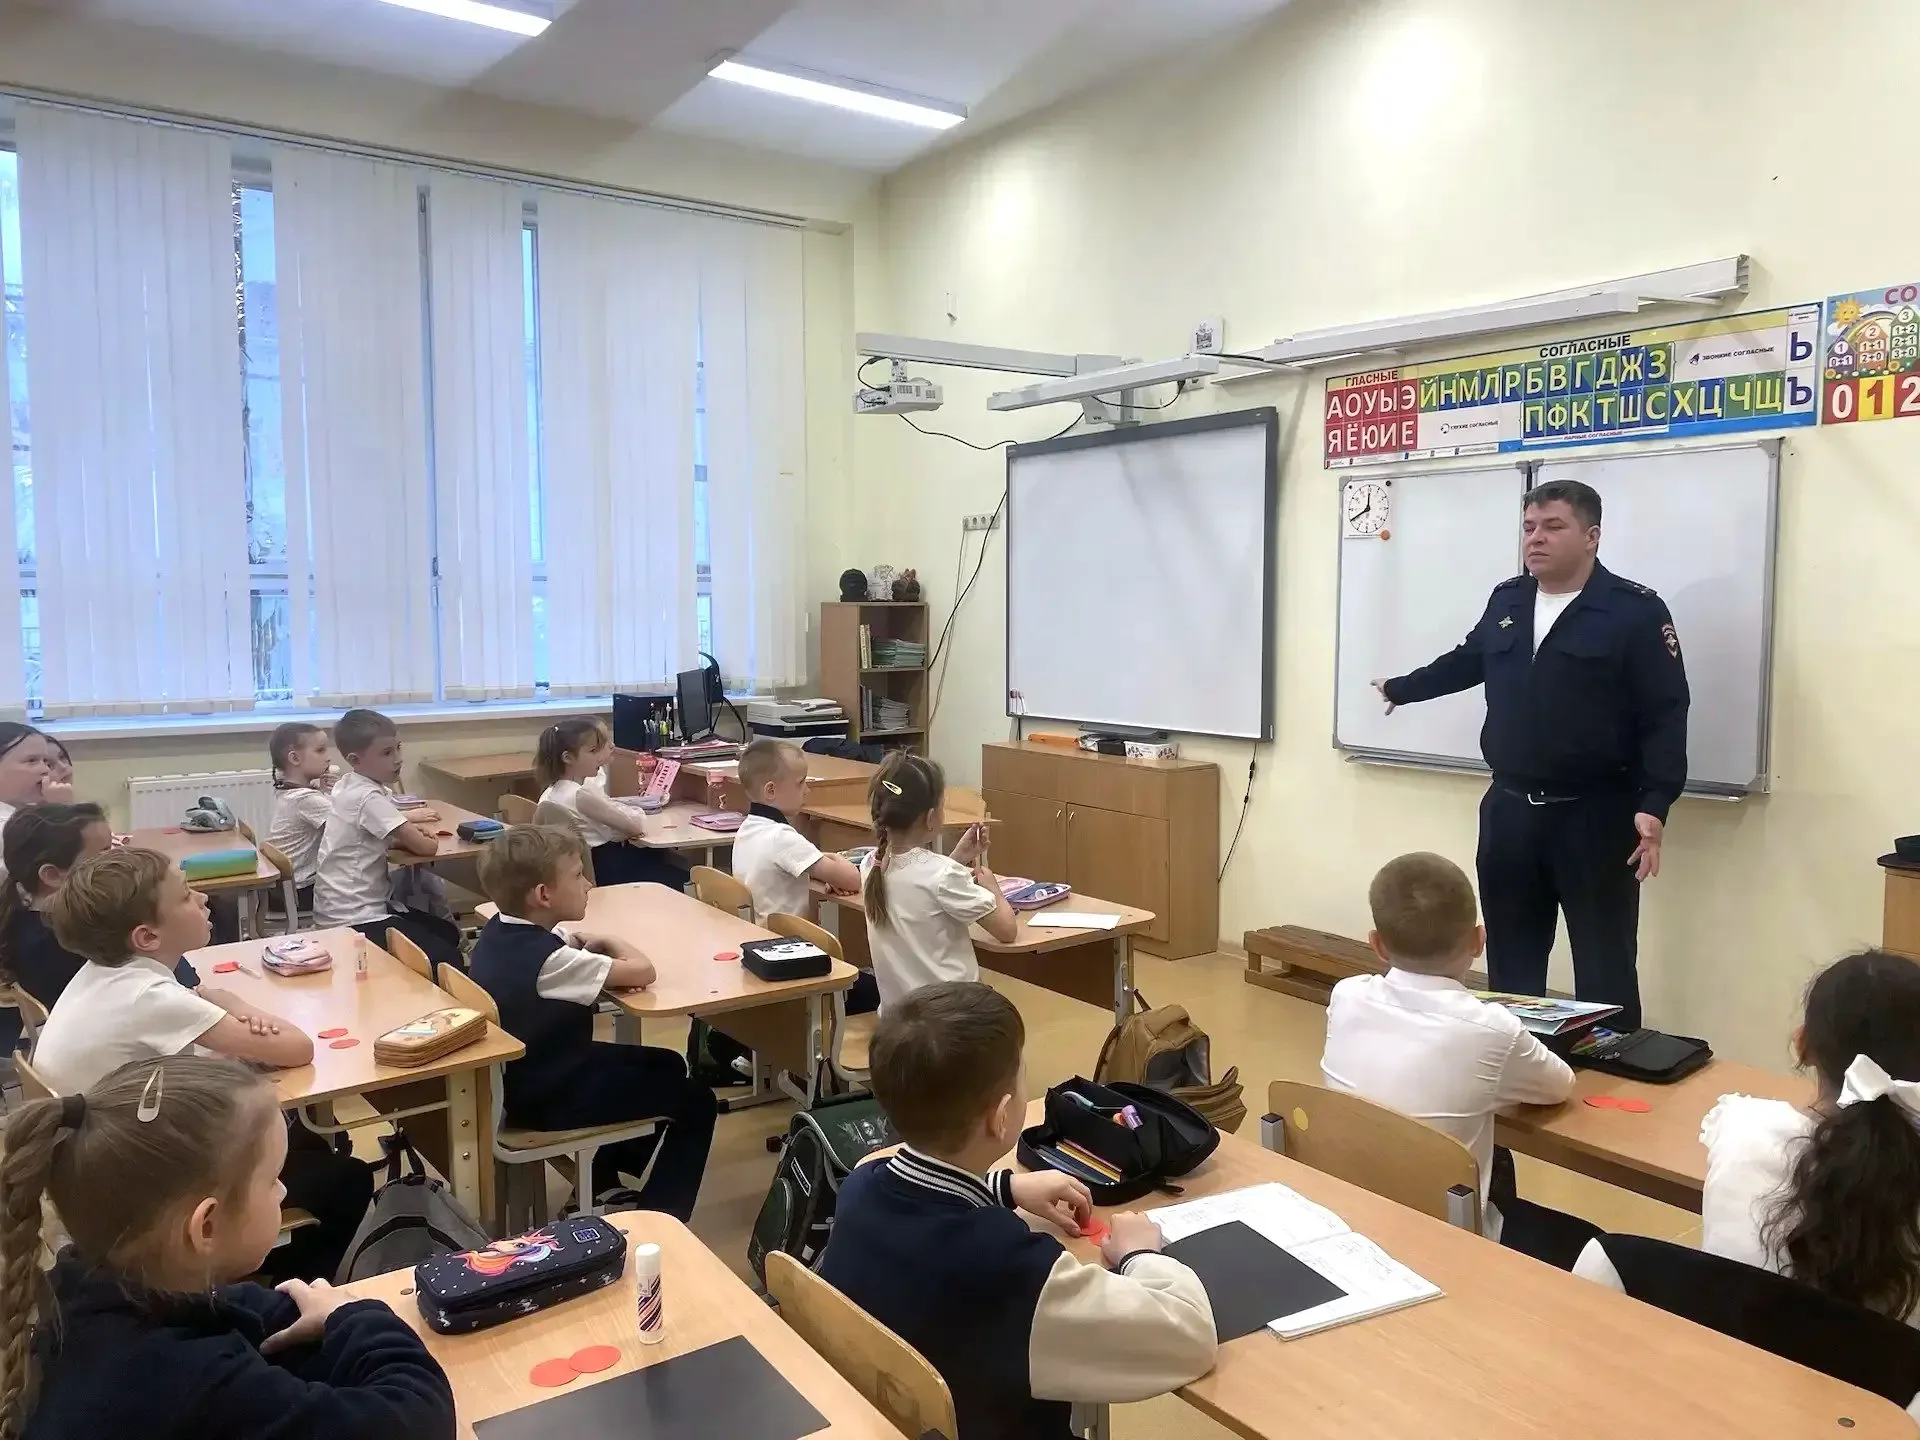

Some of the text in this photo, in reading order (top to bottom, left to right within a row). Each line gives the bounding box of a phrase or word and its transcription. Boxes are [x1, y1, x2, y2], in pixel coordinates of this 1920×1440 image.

[1540, 335, 1631, 358] СОГЛАСНЫЕ
[1702, 346, 1774, 360] ЗВОНКИЕ СОГЛАСНЫЕ
[1790, 332, 1813, 362] Ь
[1345, 370, 1398, 386] ГЛАСНЫЕ
[1787, 376, 1813, 406] Ъ
[1832, 376, 1920, 419] 0 1 2
[1469, 420, 1499, 428] СОГЛАСНЫЕ
